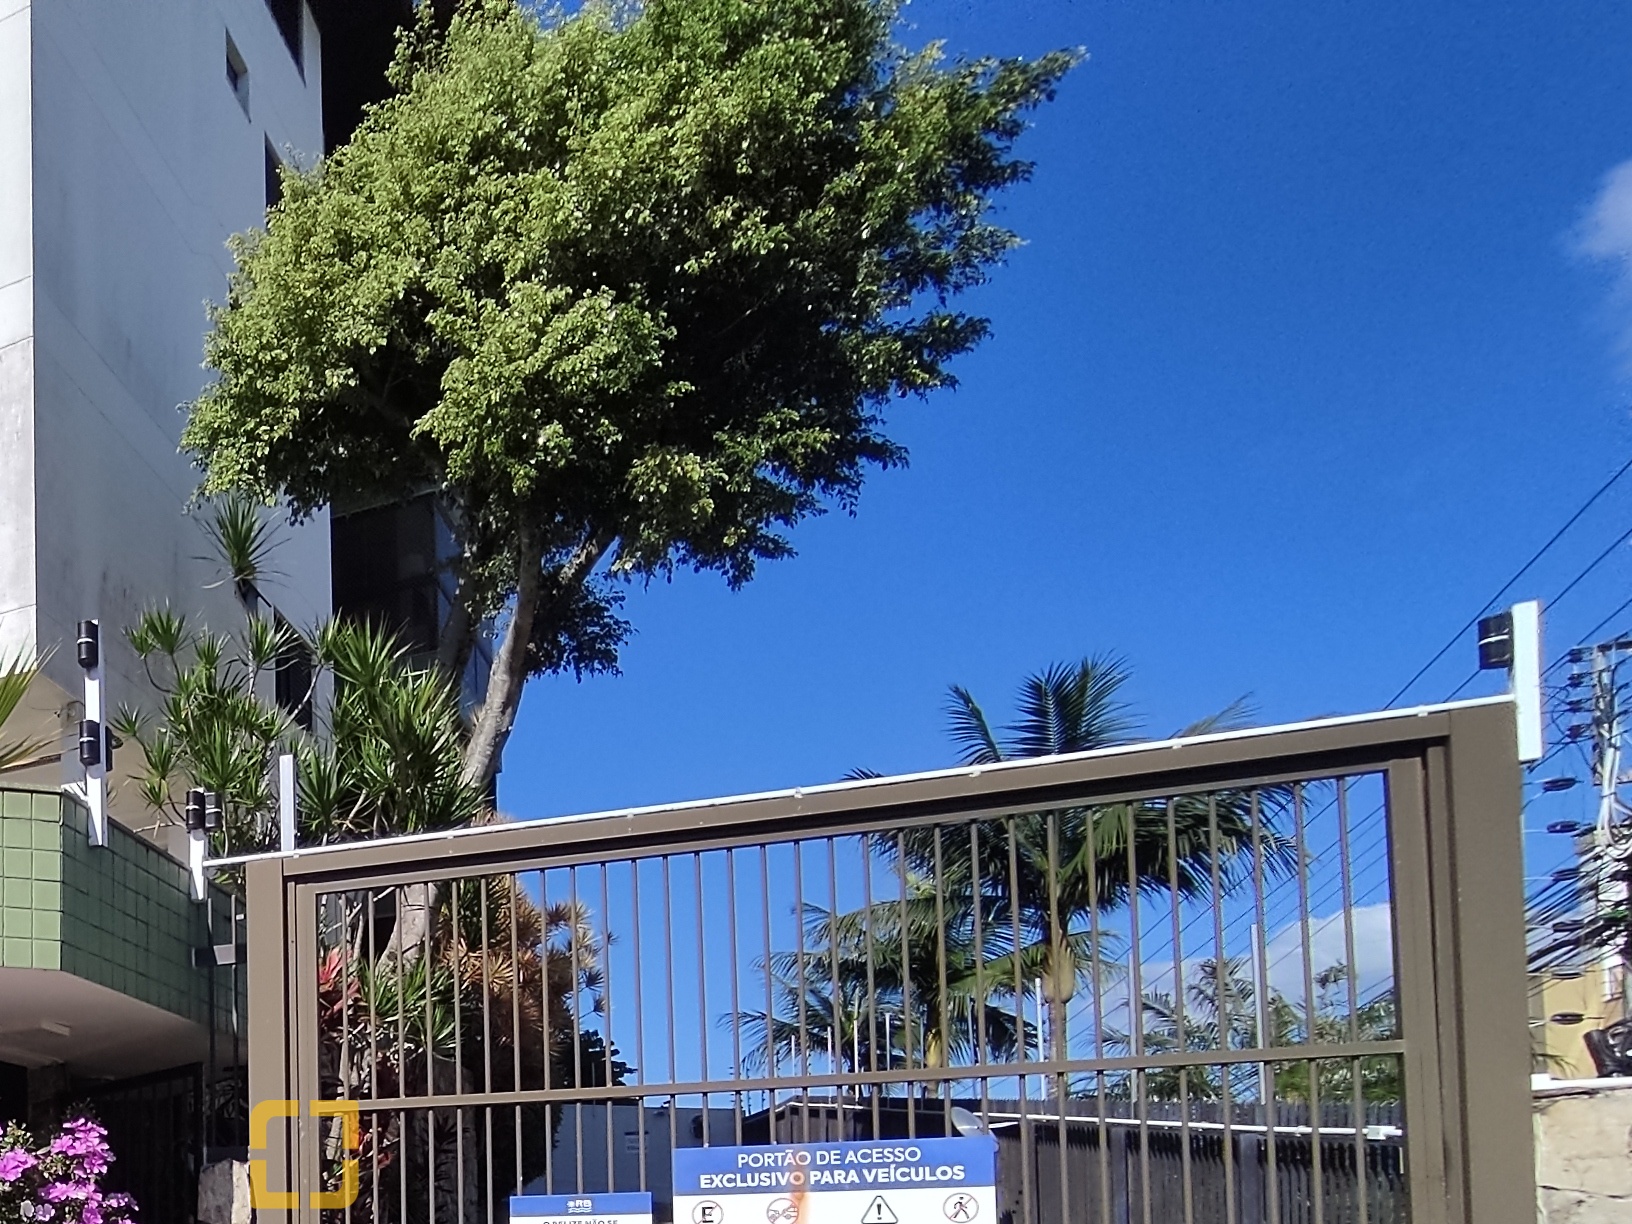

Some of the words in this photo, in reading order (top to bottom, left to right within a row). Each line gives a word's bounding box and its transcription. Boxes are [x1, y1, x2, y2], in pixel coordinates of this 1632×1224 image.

[737, 1150, 811, 1168] PORTÃO
[816, 1150, 840, 1165] DE
[844, 1147, 921, 1164] ACESSO
[699, 1172, 805, 1189] EXCLUSIVO
[809, 1170, 860, 1185] PARA
[862, 1165, 965, 1183] VEÍCULOS
